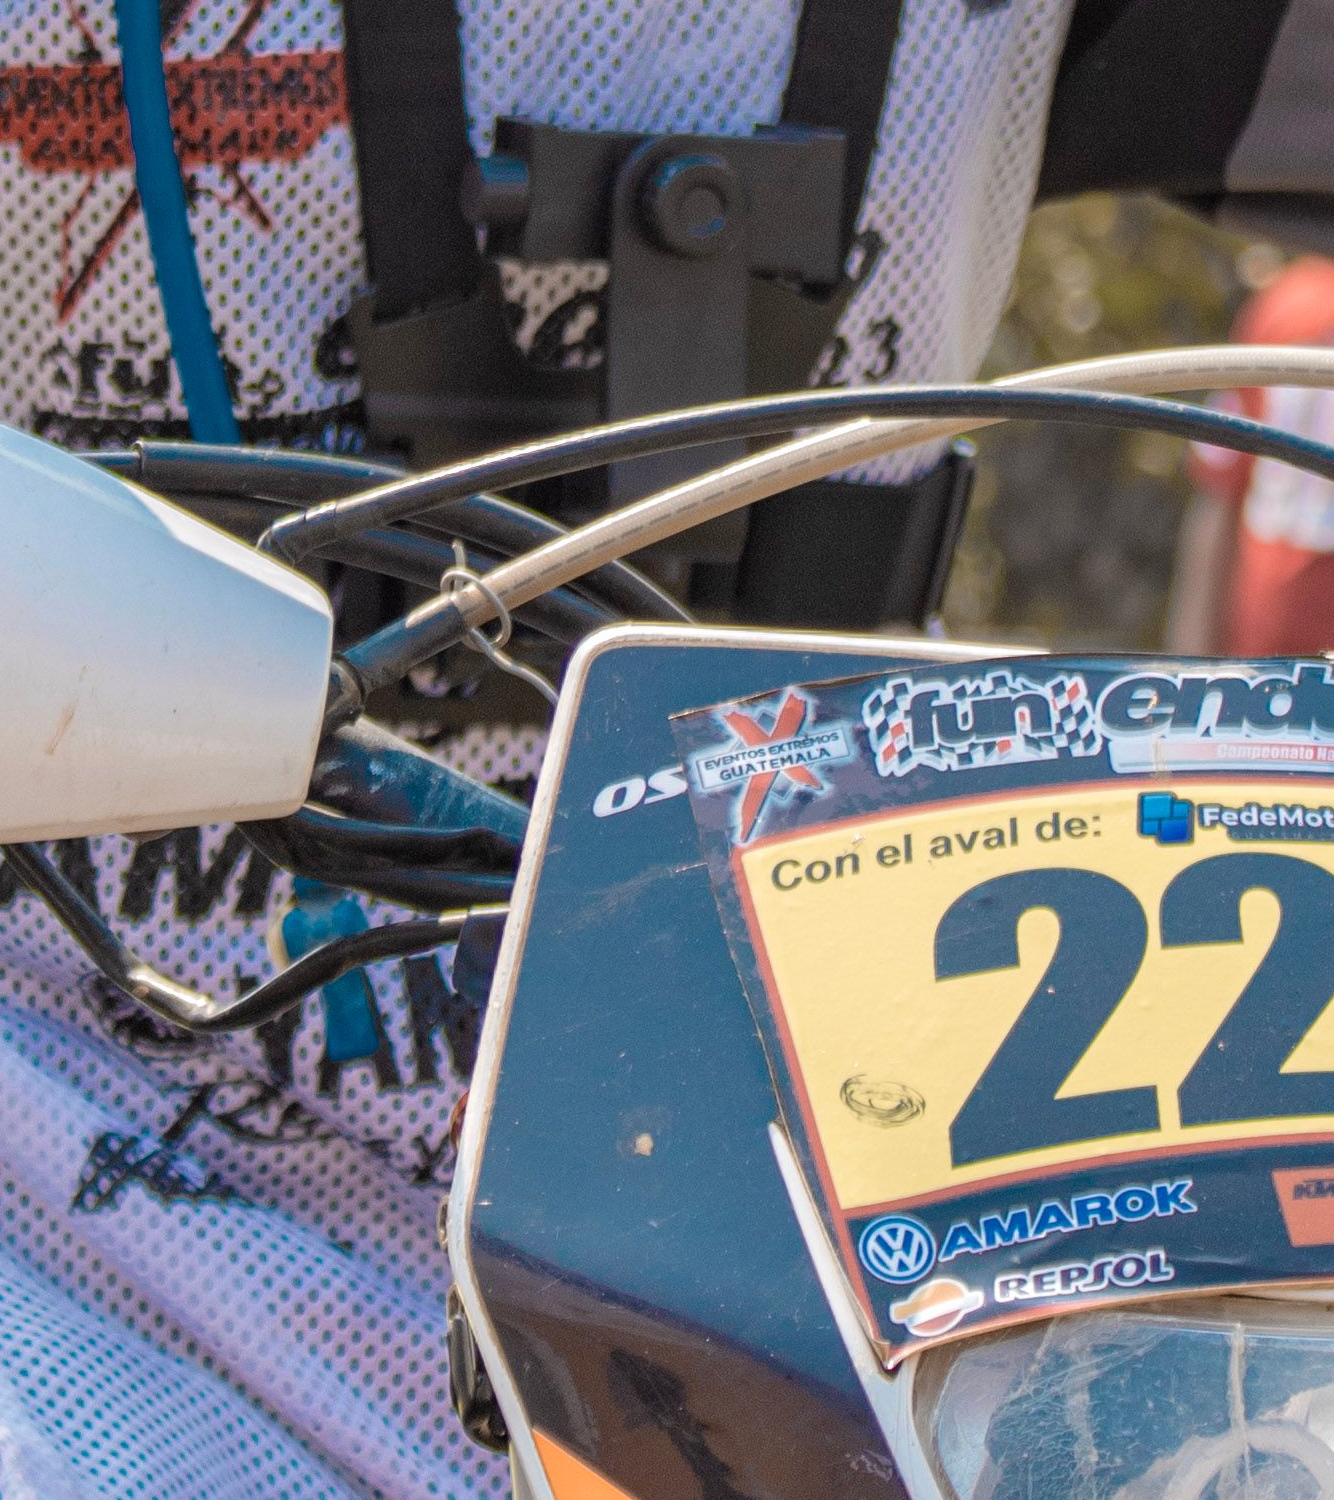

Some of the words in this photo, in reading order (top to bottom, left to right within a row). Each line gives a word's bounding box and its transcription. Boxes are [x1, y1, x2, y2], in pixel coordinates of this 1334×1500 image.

[907, 684, 1055, 750] fun
[704, 746, 768, 772] EVENTOS
[719, 747, 833, 783] GUATEMALA
[1216, 742, 1315, 763] Campeonato
[771, 850, 862, 892] Con
[876, 834, 914, 868] el
[929, 817, 1019, 860] aval
[1037, 810, 1103, 845] de:
[938, 1179, 1198, 1263] AMAROK
[994, 1250, 1176, 1303] REPSOL
